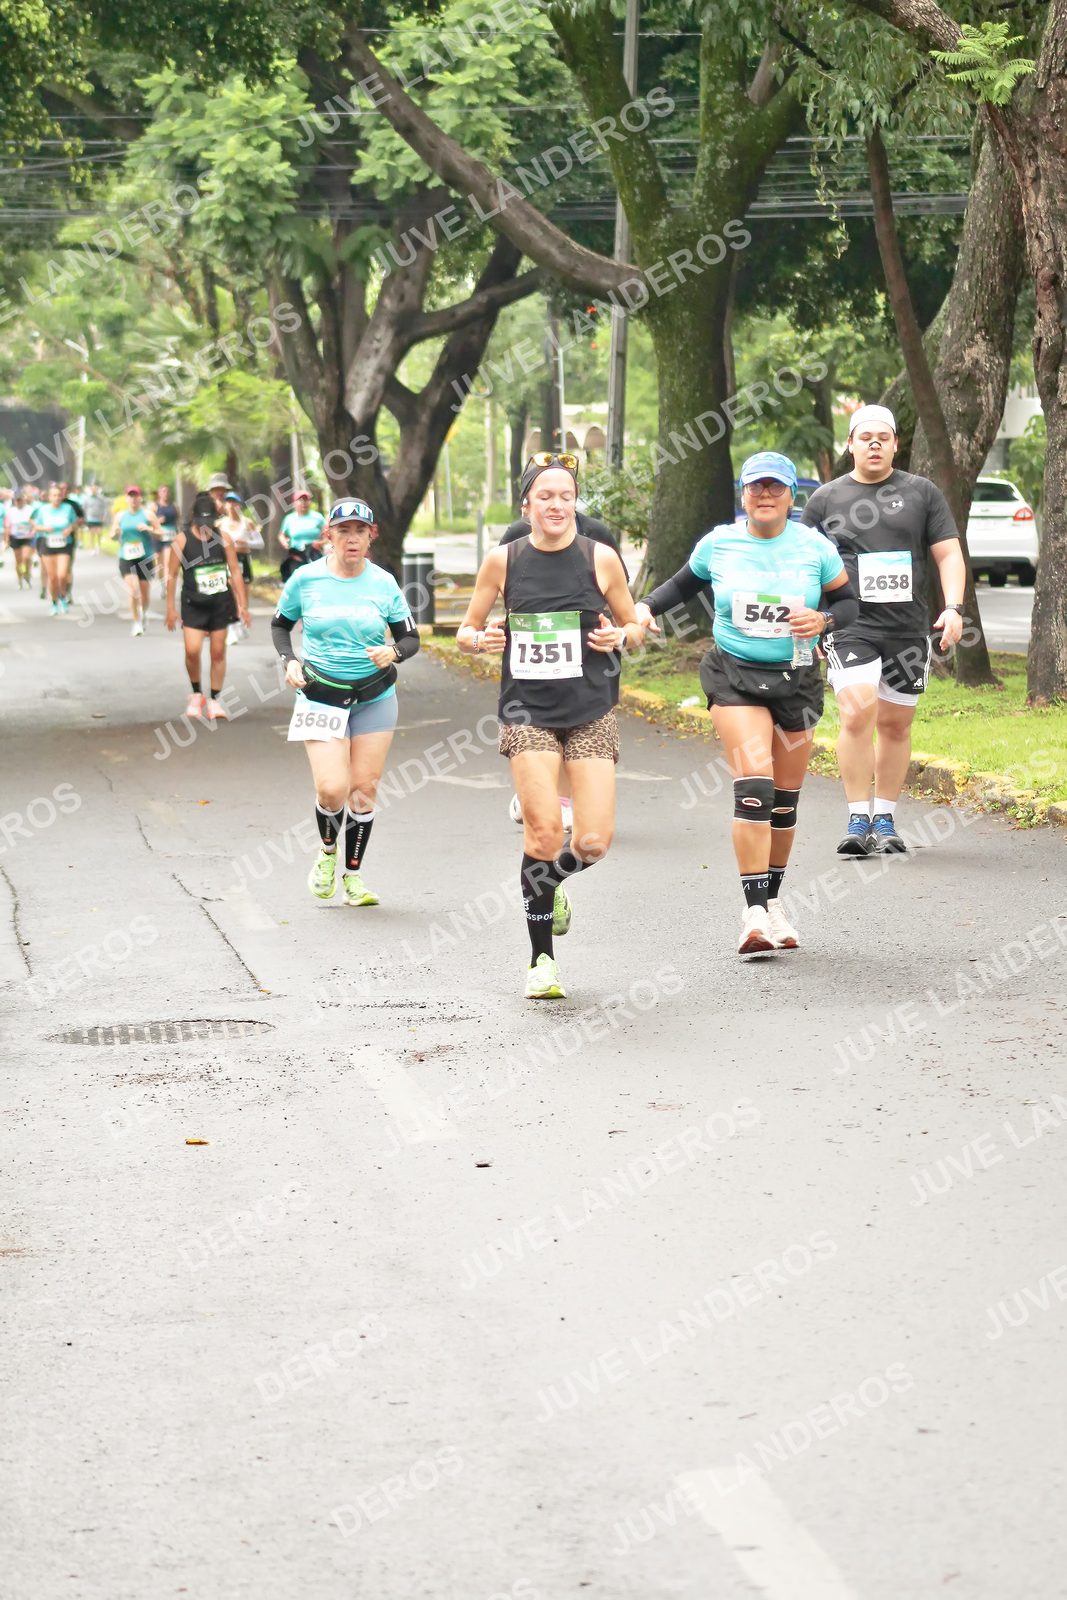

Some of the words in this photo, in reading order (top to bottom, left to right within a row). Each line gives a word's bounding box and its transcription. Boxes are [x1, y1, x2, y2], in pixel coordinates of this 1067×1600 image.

[863, 574, 909, 591] 2638
[744, 604, 790, 623] 542
[518, 642, 573, 664] 1351
[294, 712, 342, 731] 3680
